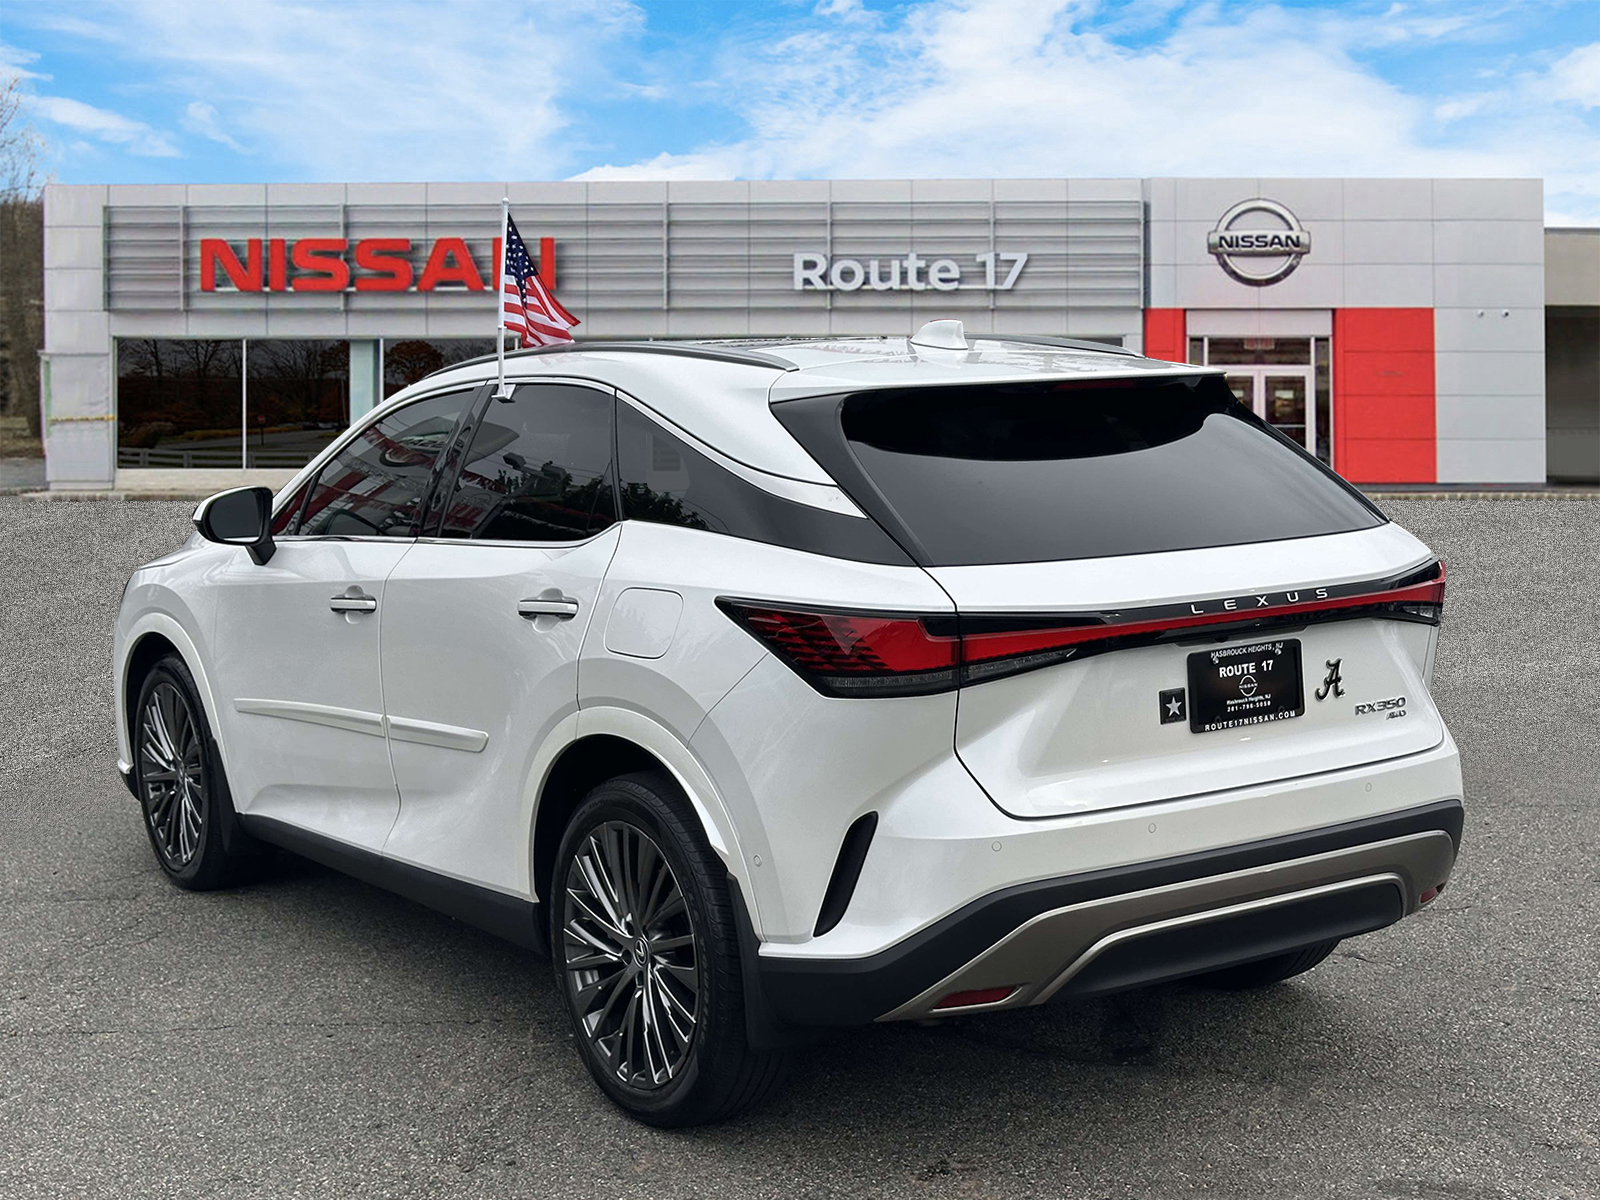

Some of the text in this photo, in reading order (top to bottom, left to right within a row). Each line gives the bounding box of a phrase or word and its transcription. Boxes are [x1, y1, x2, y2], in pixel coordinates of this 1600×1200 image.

[1218, 234, 1301, 250] NISSAN
[791, 252, 1029, 292] Route 17
[1190, 587, 1328, 615] LEXUS
[1210, 645, 1247, 659] HASBROUCK
[1219, 660, 1274, 678] ROUTE 17
[1204, 710, 1296, 732] ROUTE17NISSAN.COM
